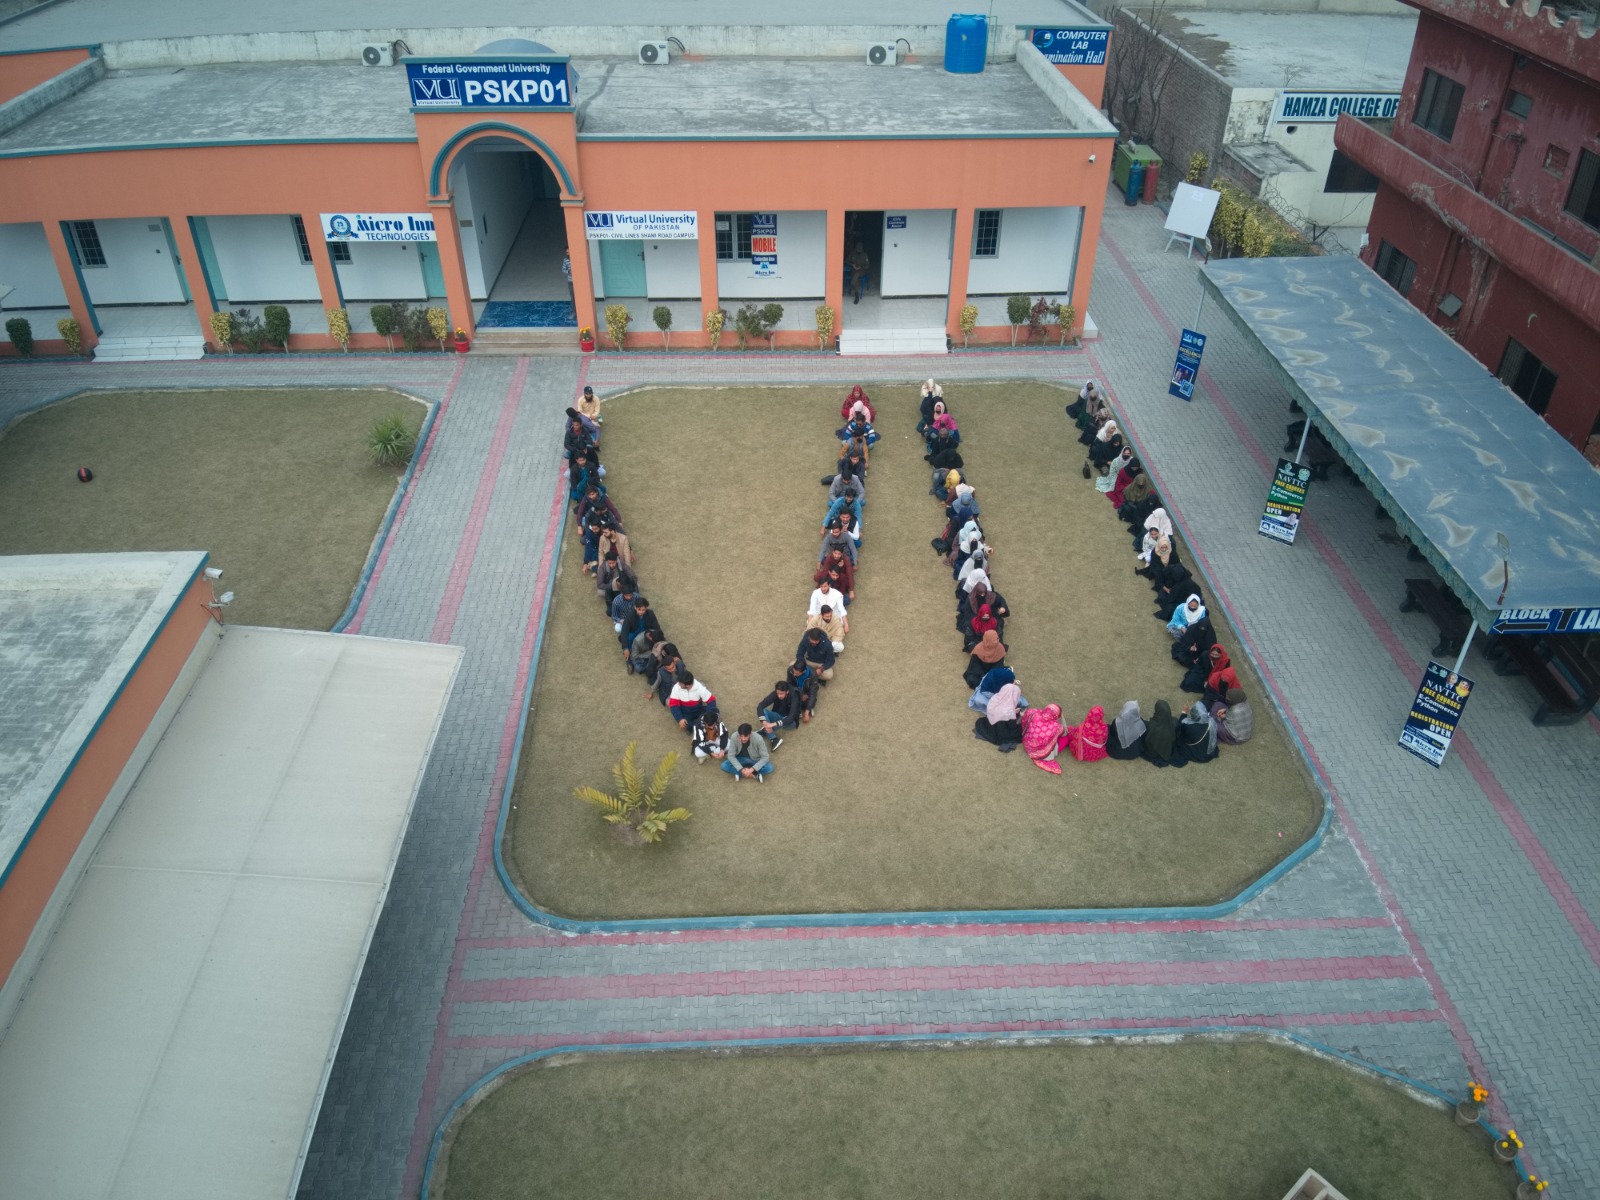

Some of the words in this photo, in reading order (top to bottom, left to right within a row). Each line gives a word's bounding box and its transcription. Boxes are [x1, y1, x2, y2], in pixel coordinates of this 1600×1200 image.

[1056, 30, 1107, 40] COMPUTER
[1071, 41, 1089, 49] LAB
[1085, 50, 1104, 64] Hall
[422, 64, 454, 74] Federal
[456, 64, 507, 73] Government
[509, 63, 551, 75] University
[464, 79, 568, 104] PSKP01
[1282, 96, 1327, 117] HAMZA
[1329, 97, 1382, 117] COLLEGE
[1382, 97, 1399, 117] OF
[356, 214, 404, 231] Micro
[407, 216, 435, 231] Inn
[616, 214, 647, 224] Virtual
[649, 213, 696, 225] University
[366, 232, 430, 241] TECHNOLOGIES
[752, 237, 776, 253] MOBILE
[1278, 473, 1308, 488] NAVTTC
[1266, 507, 1282, 515] OPEN
[1499, 609, 1553, 620] BLOCK
[1421, 686, 1436, 698] FREE
[1436, 692, 1461, 710] COURSES
[1425, 679, 1464, 702] NAVTTC
[1416, 698, 1439, 713] Python
[1418, 693, 1459, 717] E-Commerce
[1410, 711, 1454, 731] REGISTRATION
[1429, 724, 1452, 738] OPEN
